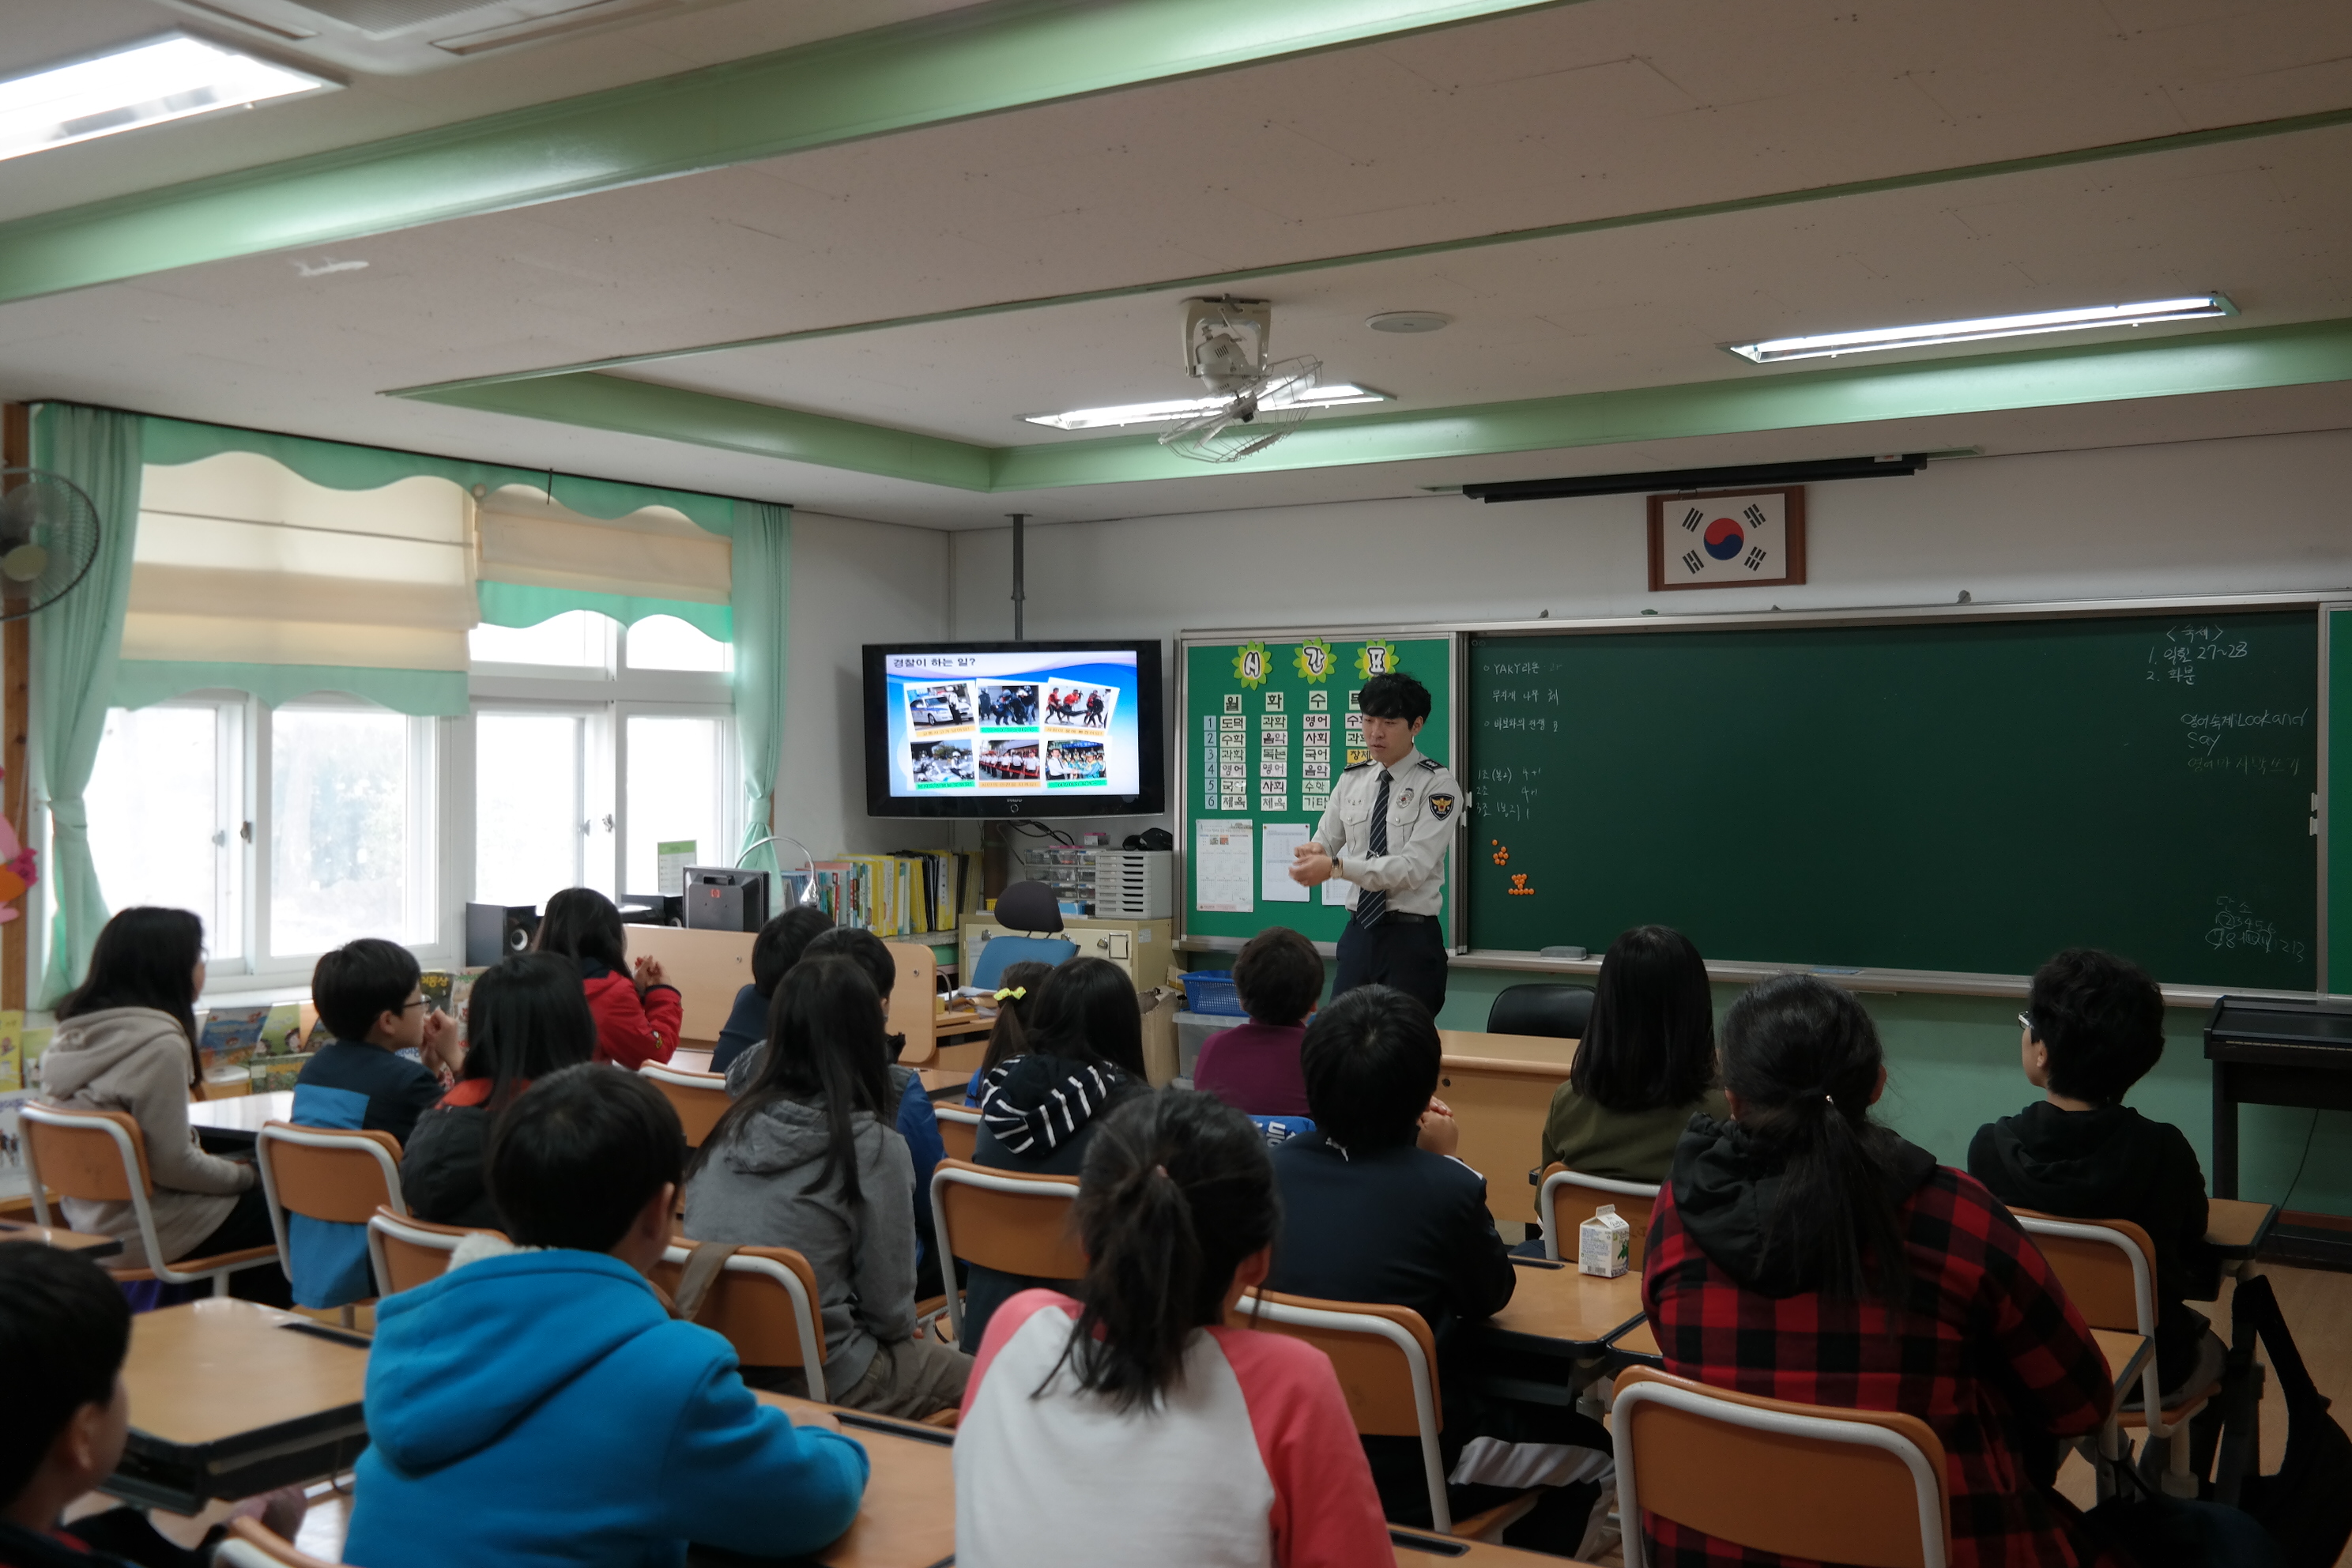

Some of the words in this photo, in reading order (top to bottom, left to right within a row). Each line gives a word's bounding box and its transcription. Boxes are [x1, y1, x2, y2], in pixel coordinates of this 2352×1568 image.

[2197, 641, 2248, 660] 27~28
[894, 658, 926, 668] 경찰이
[931, 658, 953, 667] 하는
[958, 658, 975, 667] 일?
[2168, 665, 2196, 685] 화분
[1226, 697, 1239, 711] 월
[1267, 694, 1282, 709] 화
[1310, 693, 1326, 708] 수
[1492, 689, 1516, 703] 무지개
[1523, 690, 1539, 703] 나무
[1208, 718, 1212, 728] 1
[1222, 718, 1243, 729] 도덕
[1262, 717, 1285, 728] 과학
[1305, 715, 1328, 727] 영어
[2272, 707, 2309, 727] and
[1208, 733, 1214, 744] 2
[1222, 734, 1244, 745] 수학
[1263, 733, 1286, 744] 음악
[1305, 733, 1328, 744] 사회
[1208, 748, 1214, 760] 3
[1222, 750, 1244, 761] 과학
[1305, 748, 1328, 760] 국어
[1208, 763, 1215, 775] 4
[1222, 764, 1244, 776] 영어
[1262, 764, 1284, 775] 영어
[1305, 764, 1328, 777] 음악
[1208, 780, 1215, 791] 5
[1262, 781, 1284, 793] 사회
[1305, 781, 1325, 792] 수학
[1208, 795, 1215, 807] 6
[1223, 796, 1246, 808] 체육
[1263, 797, 1286, 809] 체육
